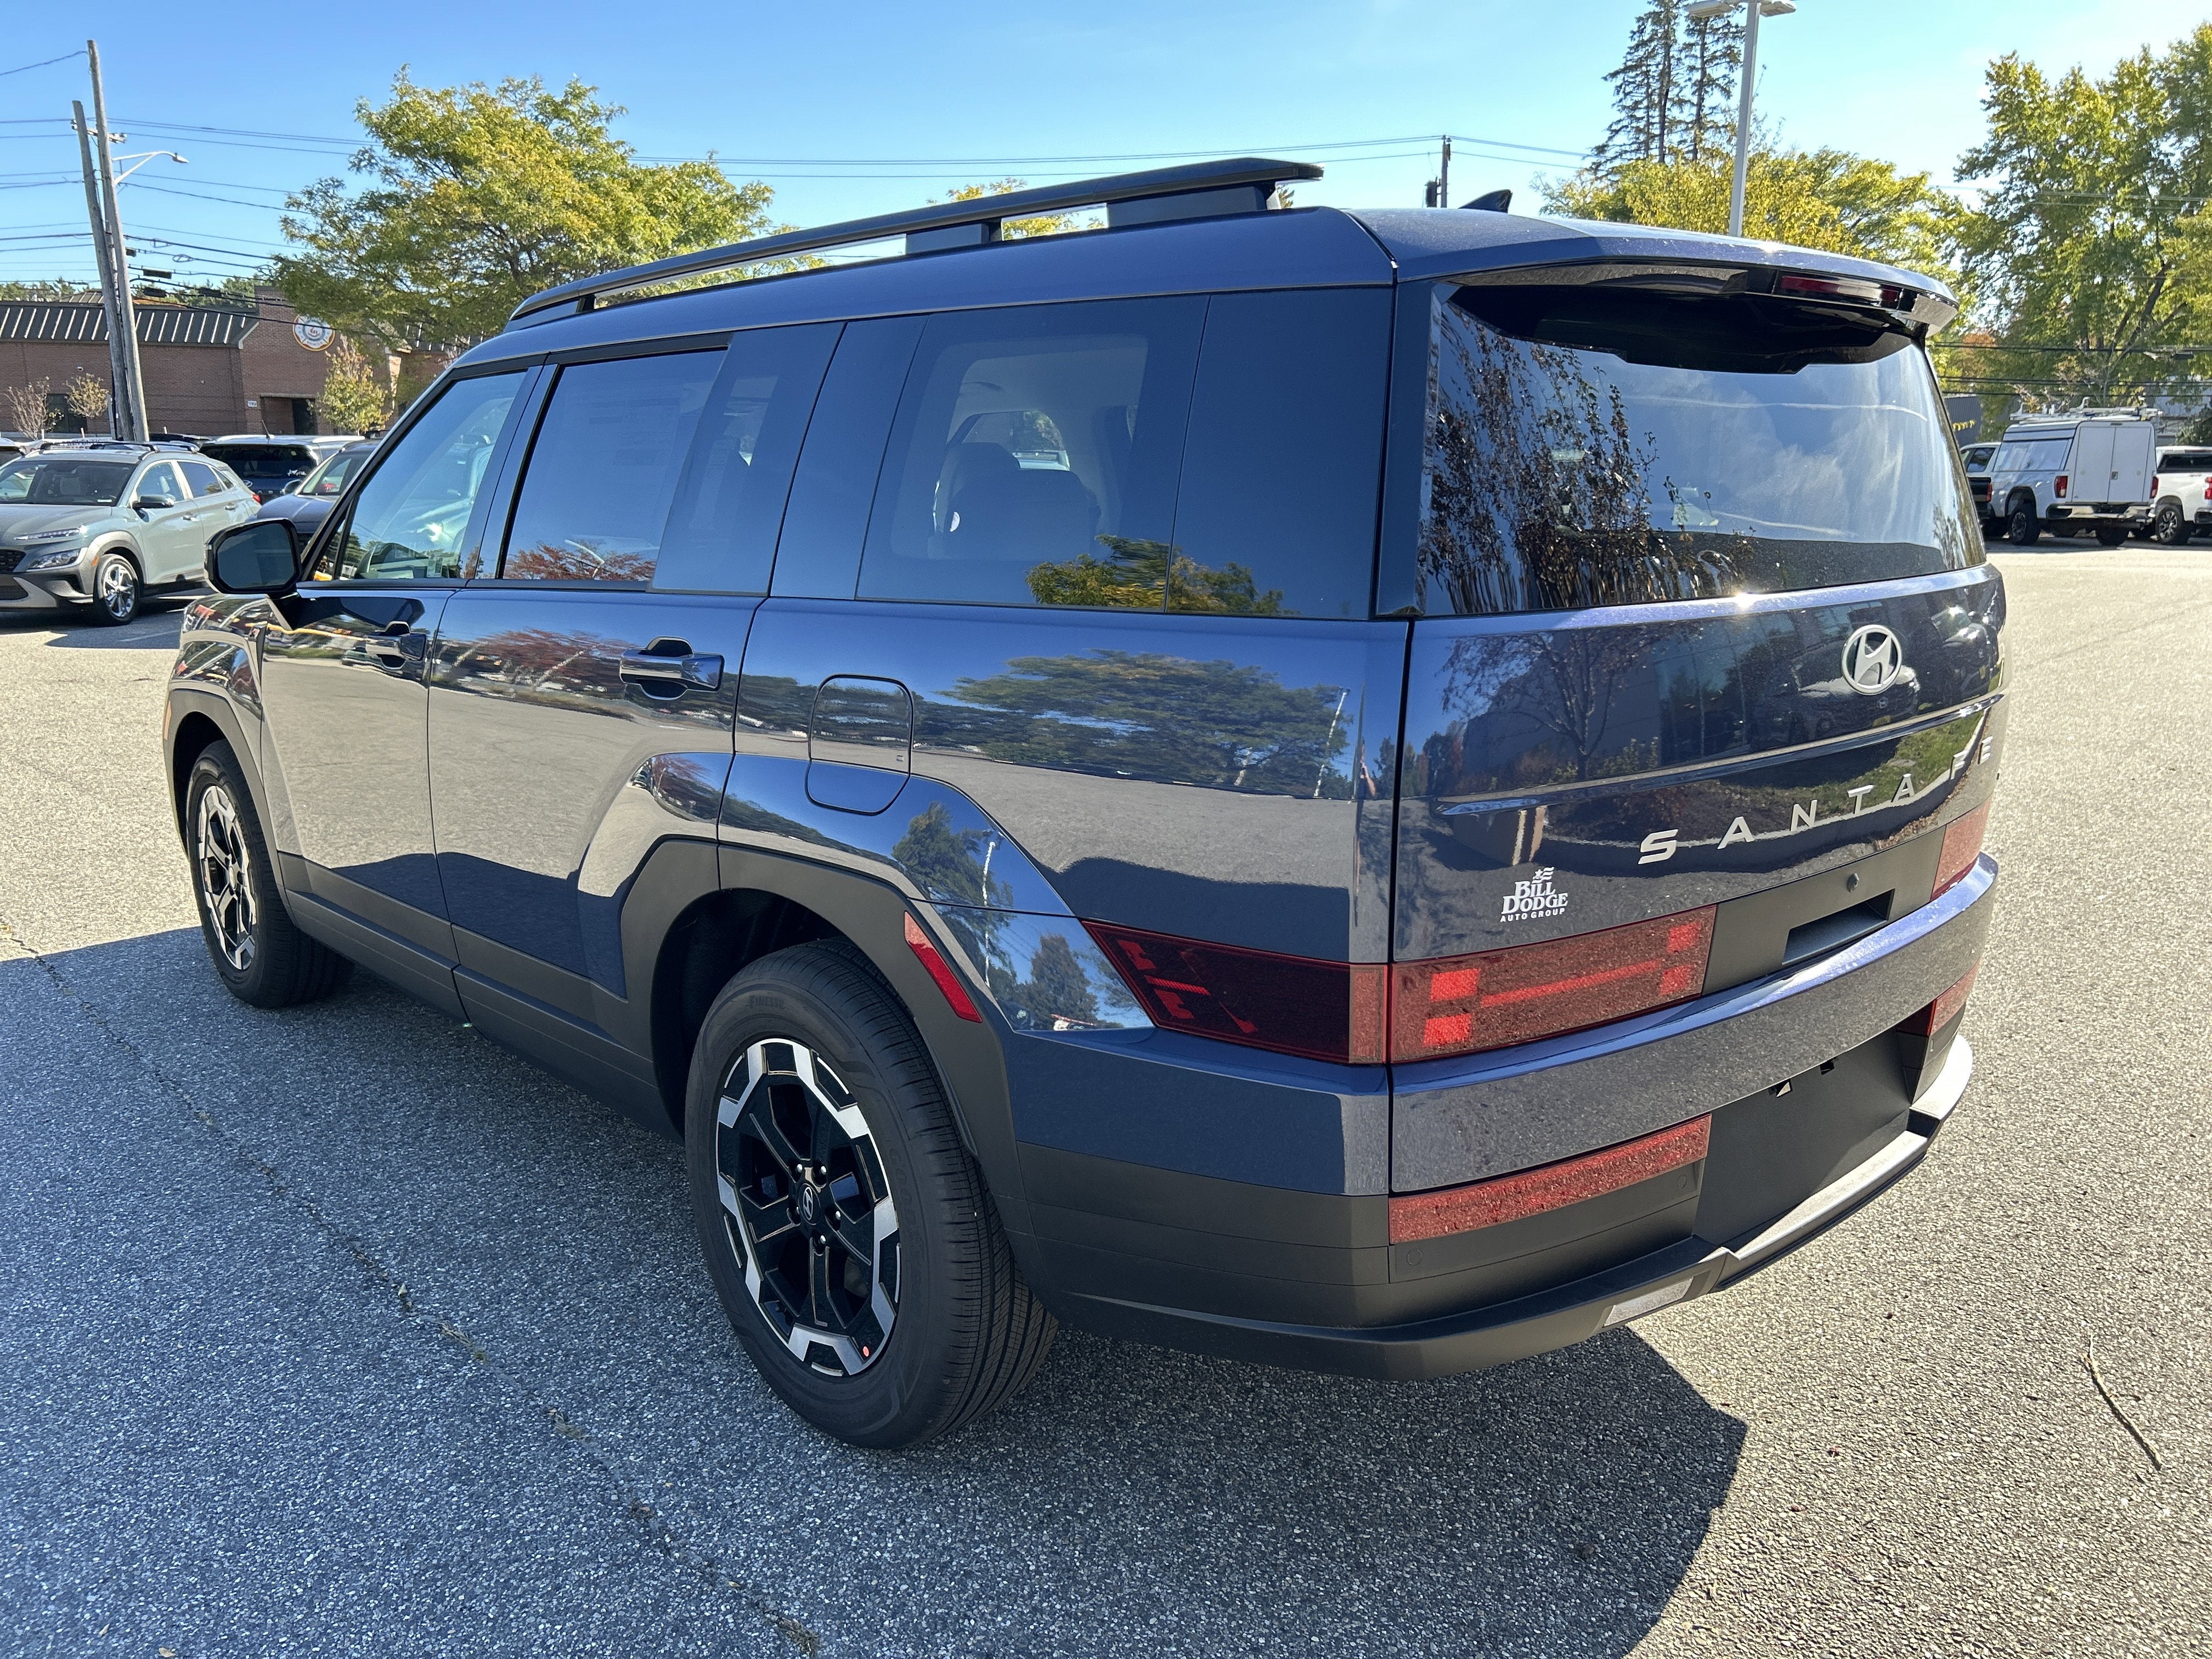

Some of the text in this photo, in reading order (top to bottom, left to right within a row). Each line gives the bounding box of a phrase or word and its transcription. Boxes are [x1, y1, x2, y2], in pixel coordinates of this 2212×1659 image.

[1638, 736, 1994, 865] SANTA FE
[1515, 881, 1556, 899] BILL
[1501, 893, 1568, 915] DODGE
[1500, 908, 1565, 922] AUTO GROUP
